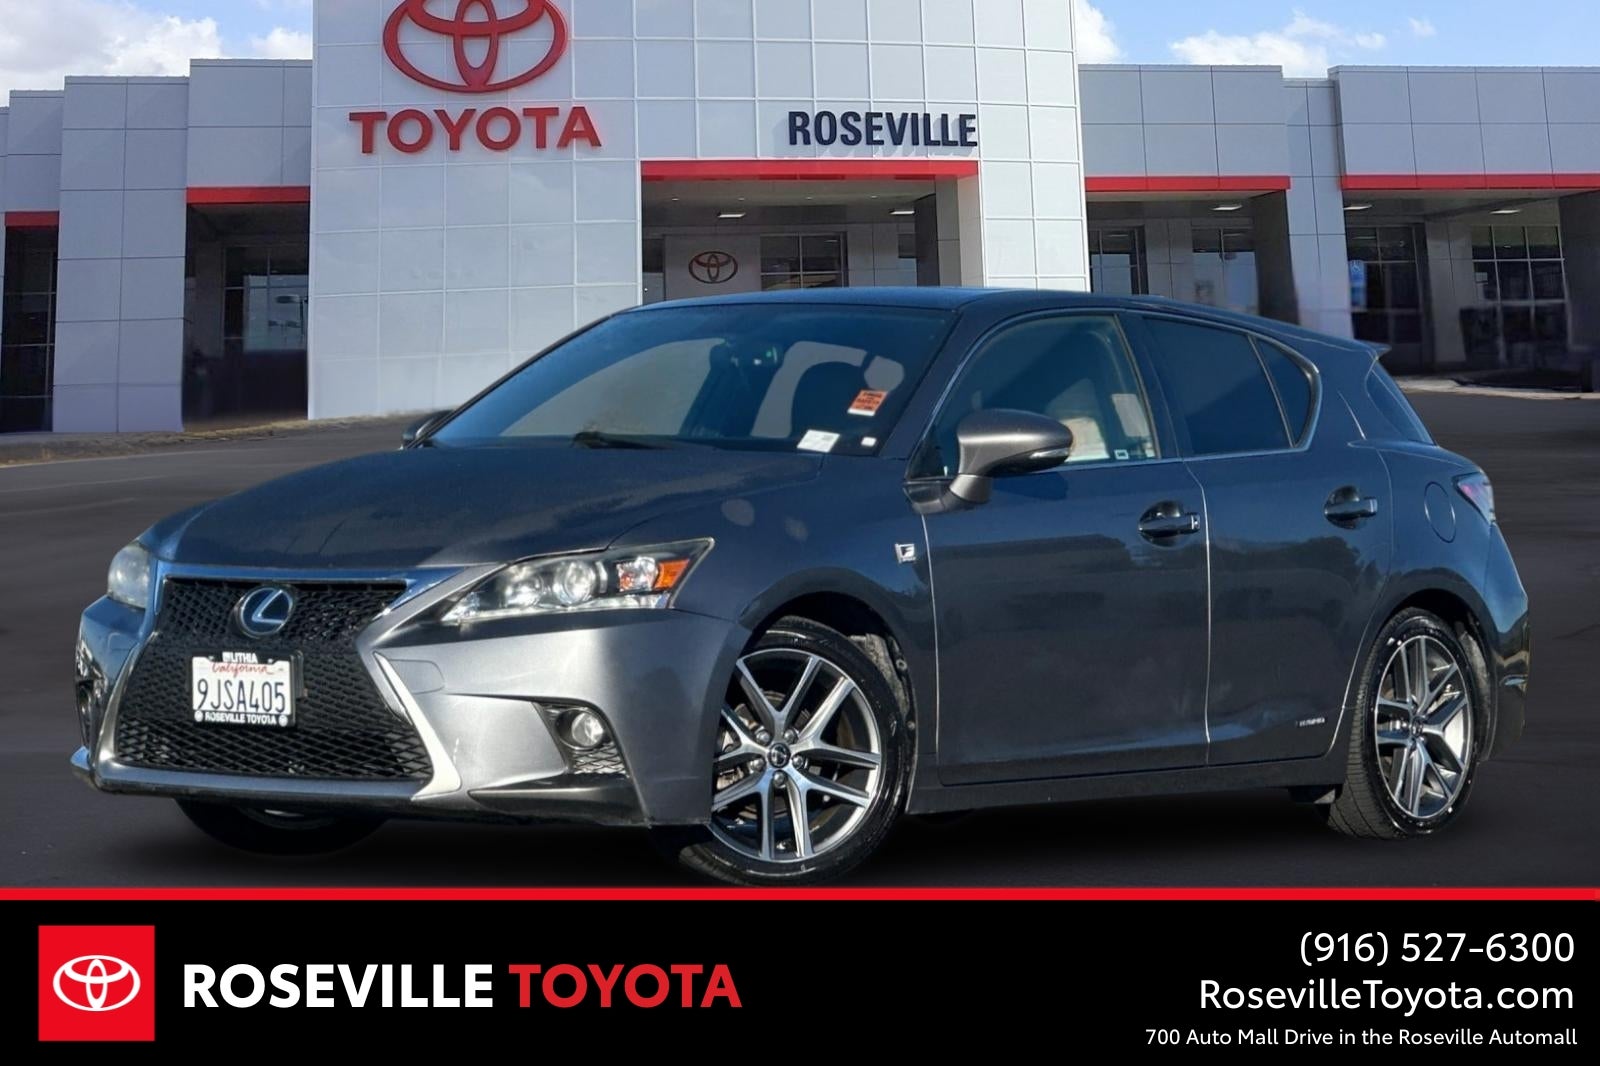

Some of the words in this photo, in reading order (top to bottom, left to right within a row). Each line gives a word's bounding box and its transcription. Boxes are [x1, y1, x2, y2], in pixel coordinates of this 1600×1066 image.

[350, 106, 602, 154] TOYOTA
[788, 110, 978, 147] ROSEVILLE
[211, 662, 275, 678] California
[231, 651, 258, 663] LITHIA
[197, 677, 286, 714] 9JSA405
[205, 711, 245, 724] ROSEVILLE
[246, 713, 277, 725] TOYOTA
